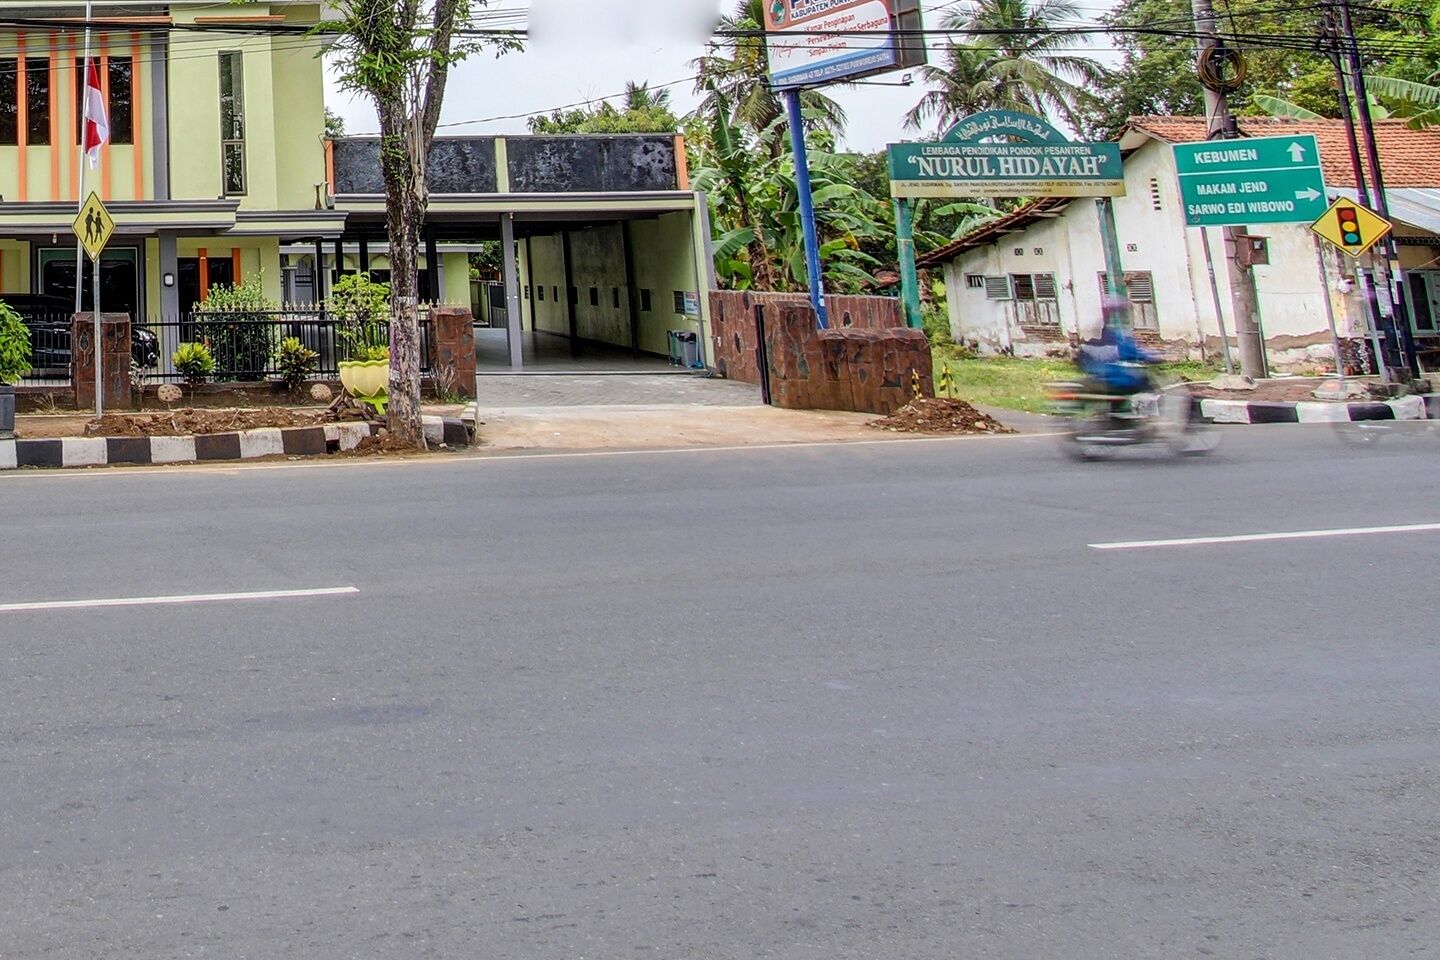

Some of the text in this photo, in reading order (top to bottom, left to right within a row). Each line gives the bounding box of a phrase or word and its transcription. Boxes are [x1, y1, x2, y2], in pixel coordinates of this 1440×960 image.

[791, 1, 829, 19] KABUPATEN
[824, 14, 856, 28] Penginapan
[857, 16, 888, 30] Serbaguna
[922, 146, 1091, 155] LEMBAGA PENDIDIKAN PONDOK PESANTREN
[1194, 149, 1258, 164] KEBUMEN
[1196, 182, 1268, 195] MAKAM JEND
[1188, 200, 1294, 215] SARWO EDI WIBOWO
